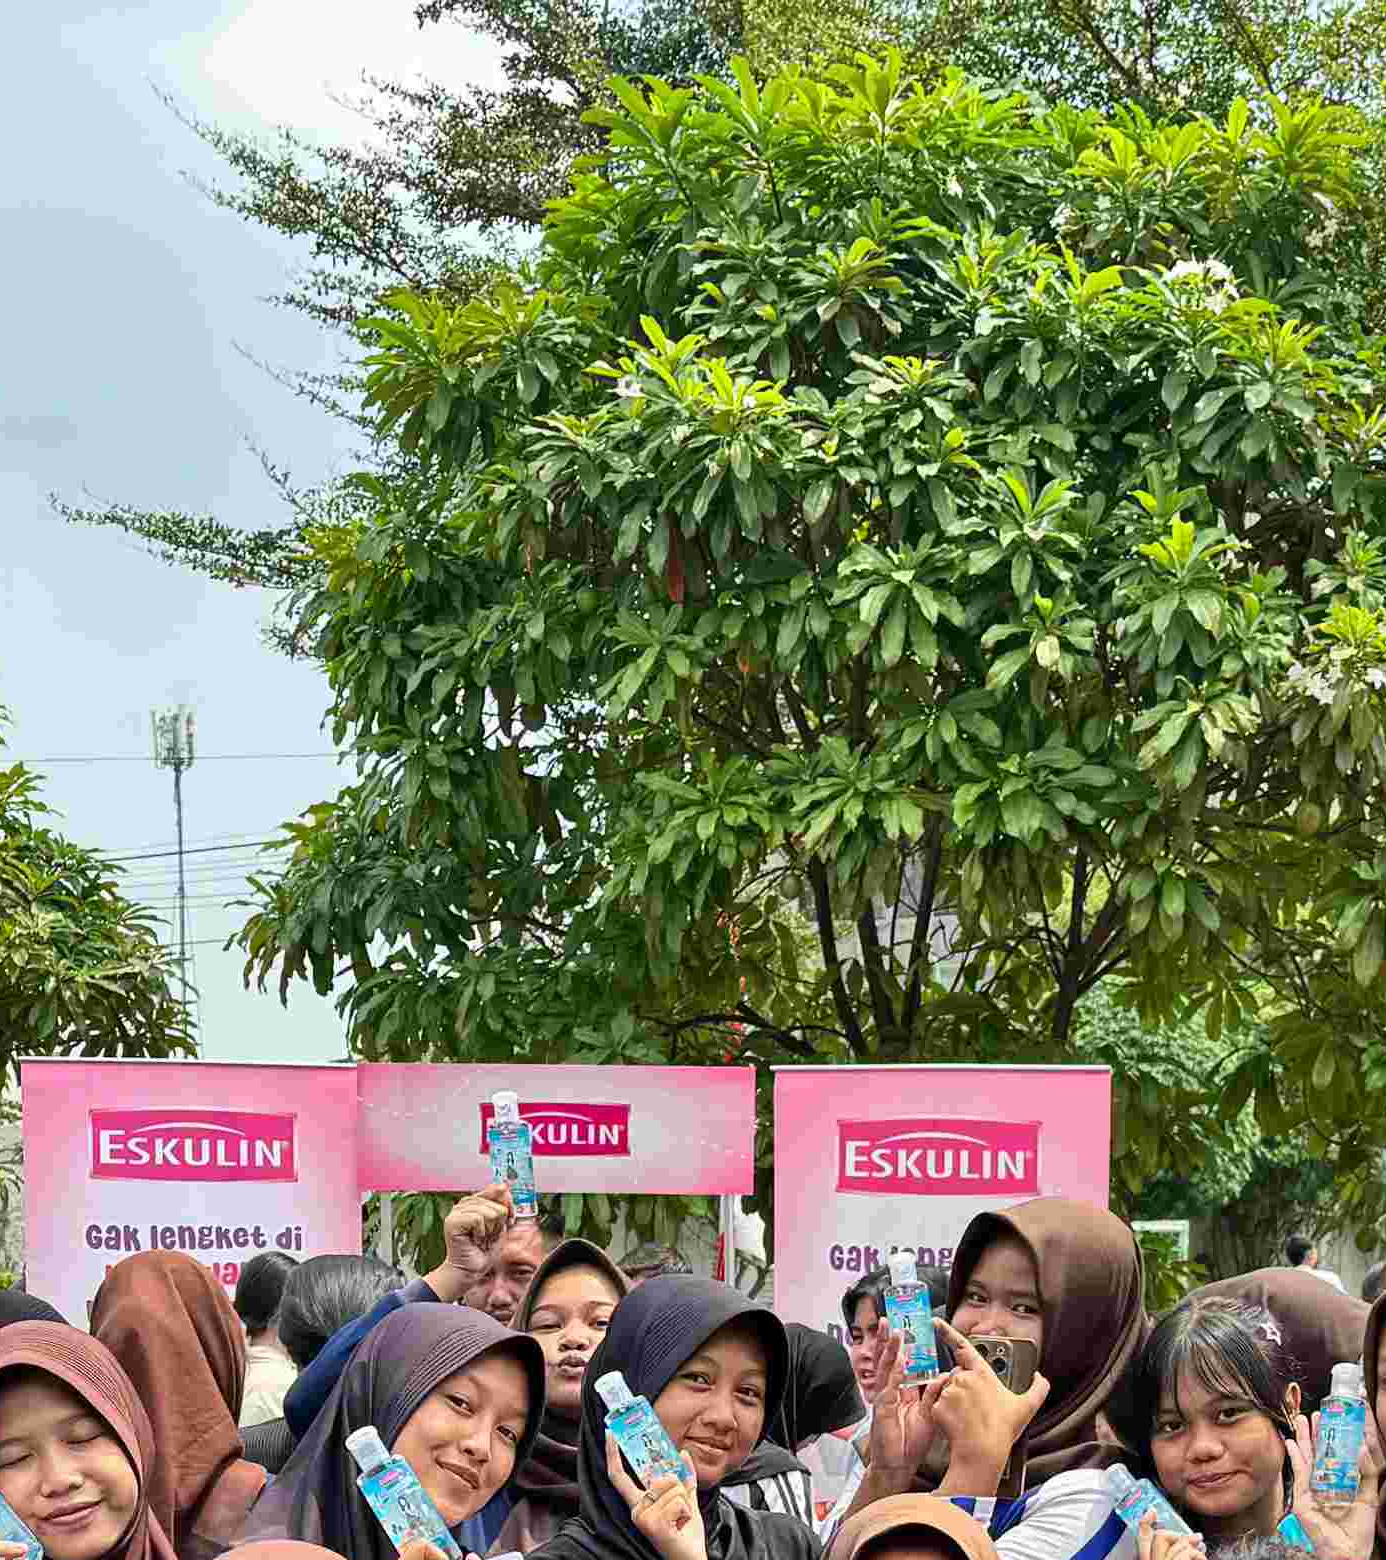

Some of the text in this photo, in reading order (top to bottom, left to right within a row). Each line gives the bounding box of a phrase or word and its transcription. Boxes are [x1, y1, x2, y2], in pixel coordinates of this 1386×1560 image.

[487, 1118, 620, 1145] KULIN
[99, 1129, 283, 1168] ESKULIN
[844, 1140, 1026, 1180] ESKULIN
[85, 1224, 142, 1251] Gak
[275, 1226, 302, 1250] di
